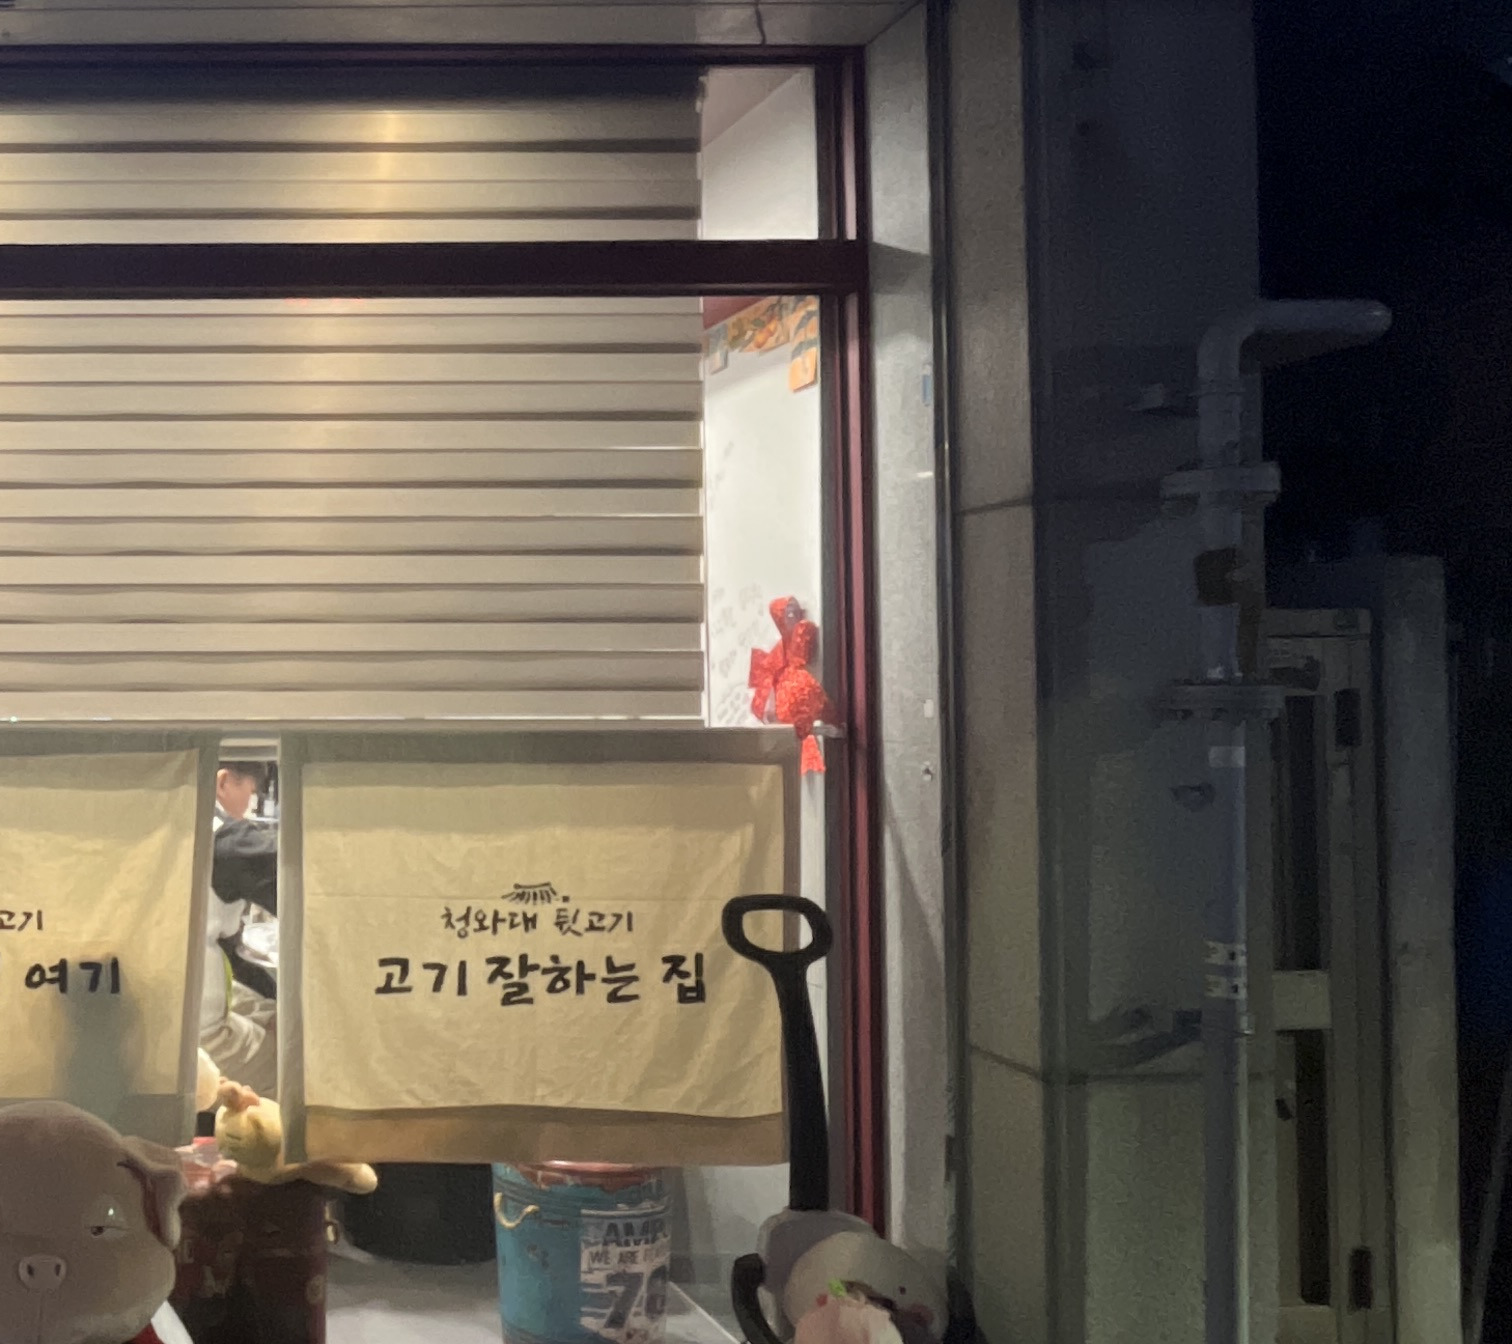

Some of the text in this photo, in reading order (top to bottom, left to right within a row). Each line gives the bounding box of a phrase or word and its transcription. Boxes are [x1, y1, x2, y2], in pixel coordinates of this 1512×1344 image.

[440, 905, 634, 939] 청와대 뒷고기
[24, 956, 122, 995] 여기
[374, 952, 707, 1007] 고기 잘하는 집
